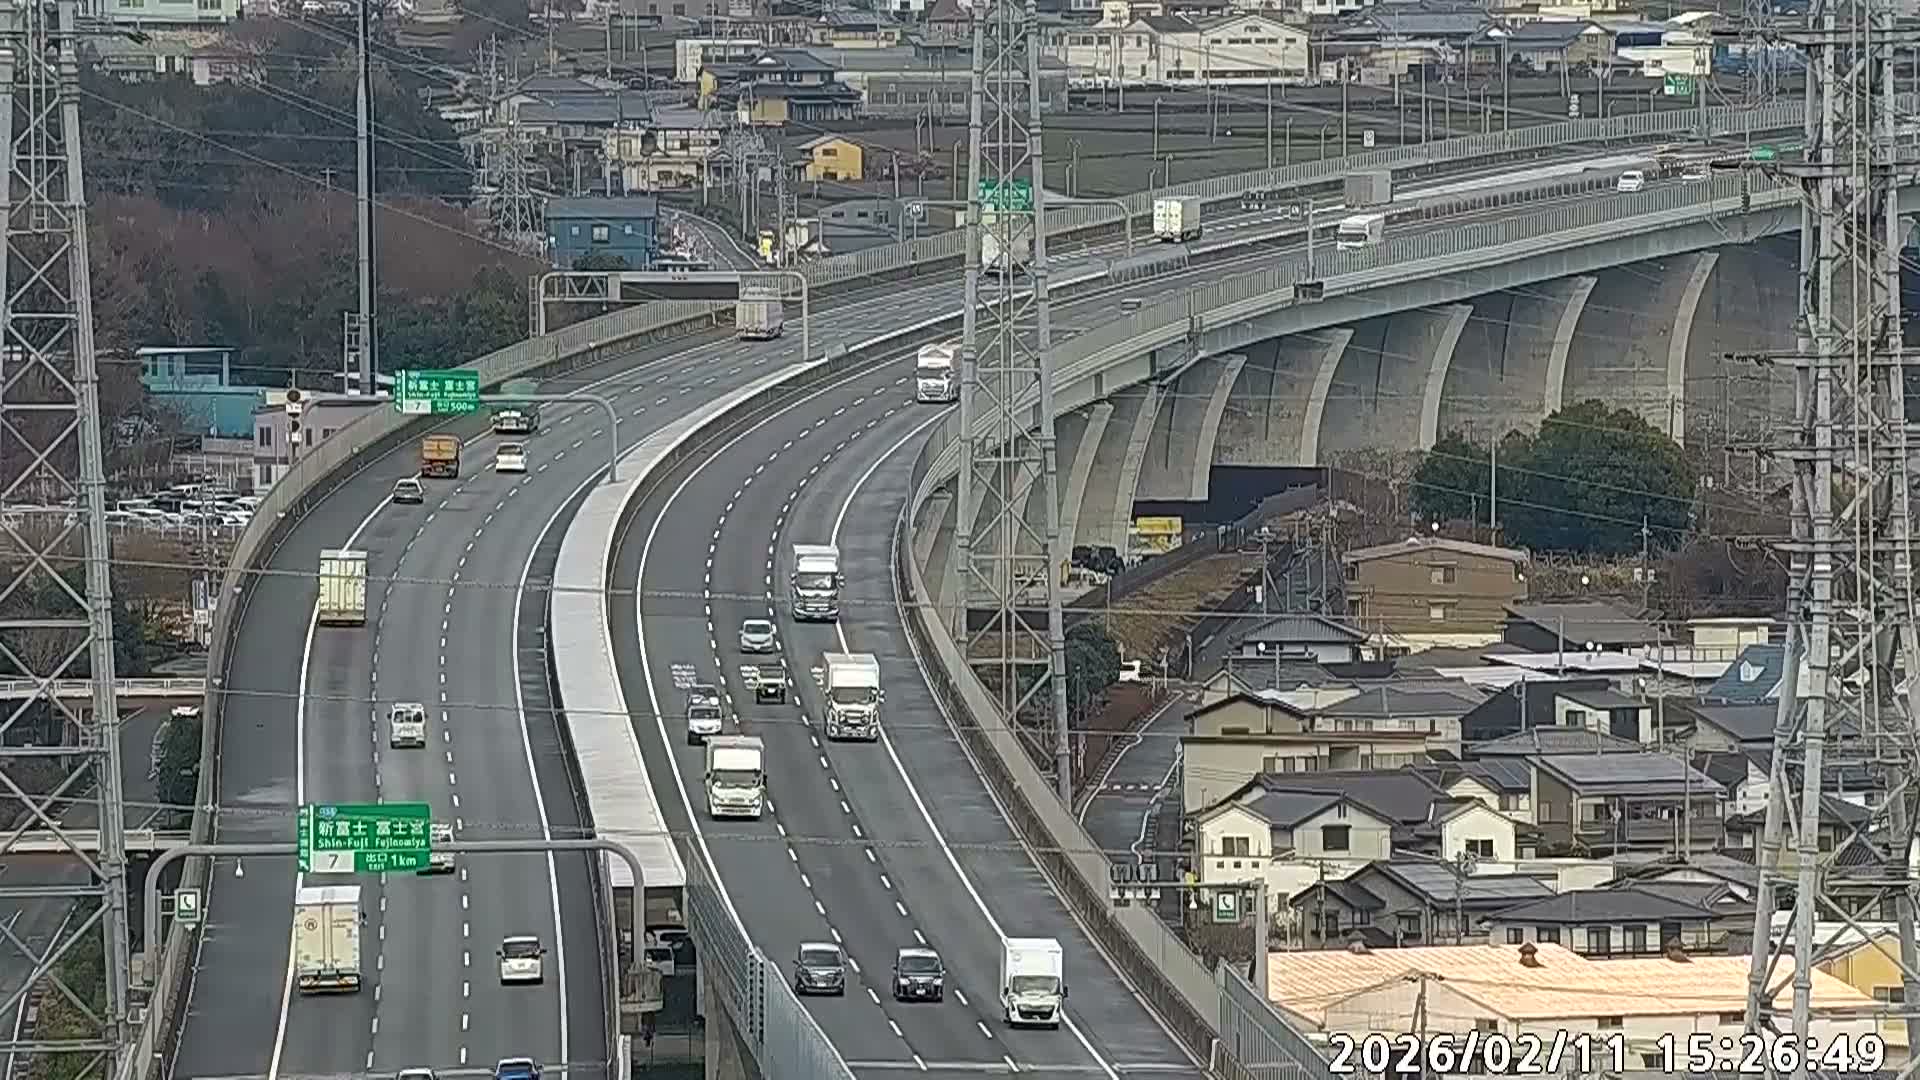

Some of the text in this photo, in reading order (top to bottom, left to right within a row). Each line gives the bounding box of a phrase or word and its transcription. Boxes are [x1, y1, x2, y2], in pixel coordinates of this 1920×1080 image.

[319, 820, 425, 836] 新富士 富士宮
[318, 837, 426, 849] Shin-Fuji Fujinomiya
[328, 854, 339, 870] 7
[366, 853, 388, 863] 出口
[391, 854, 417, 867] 1km
